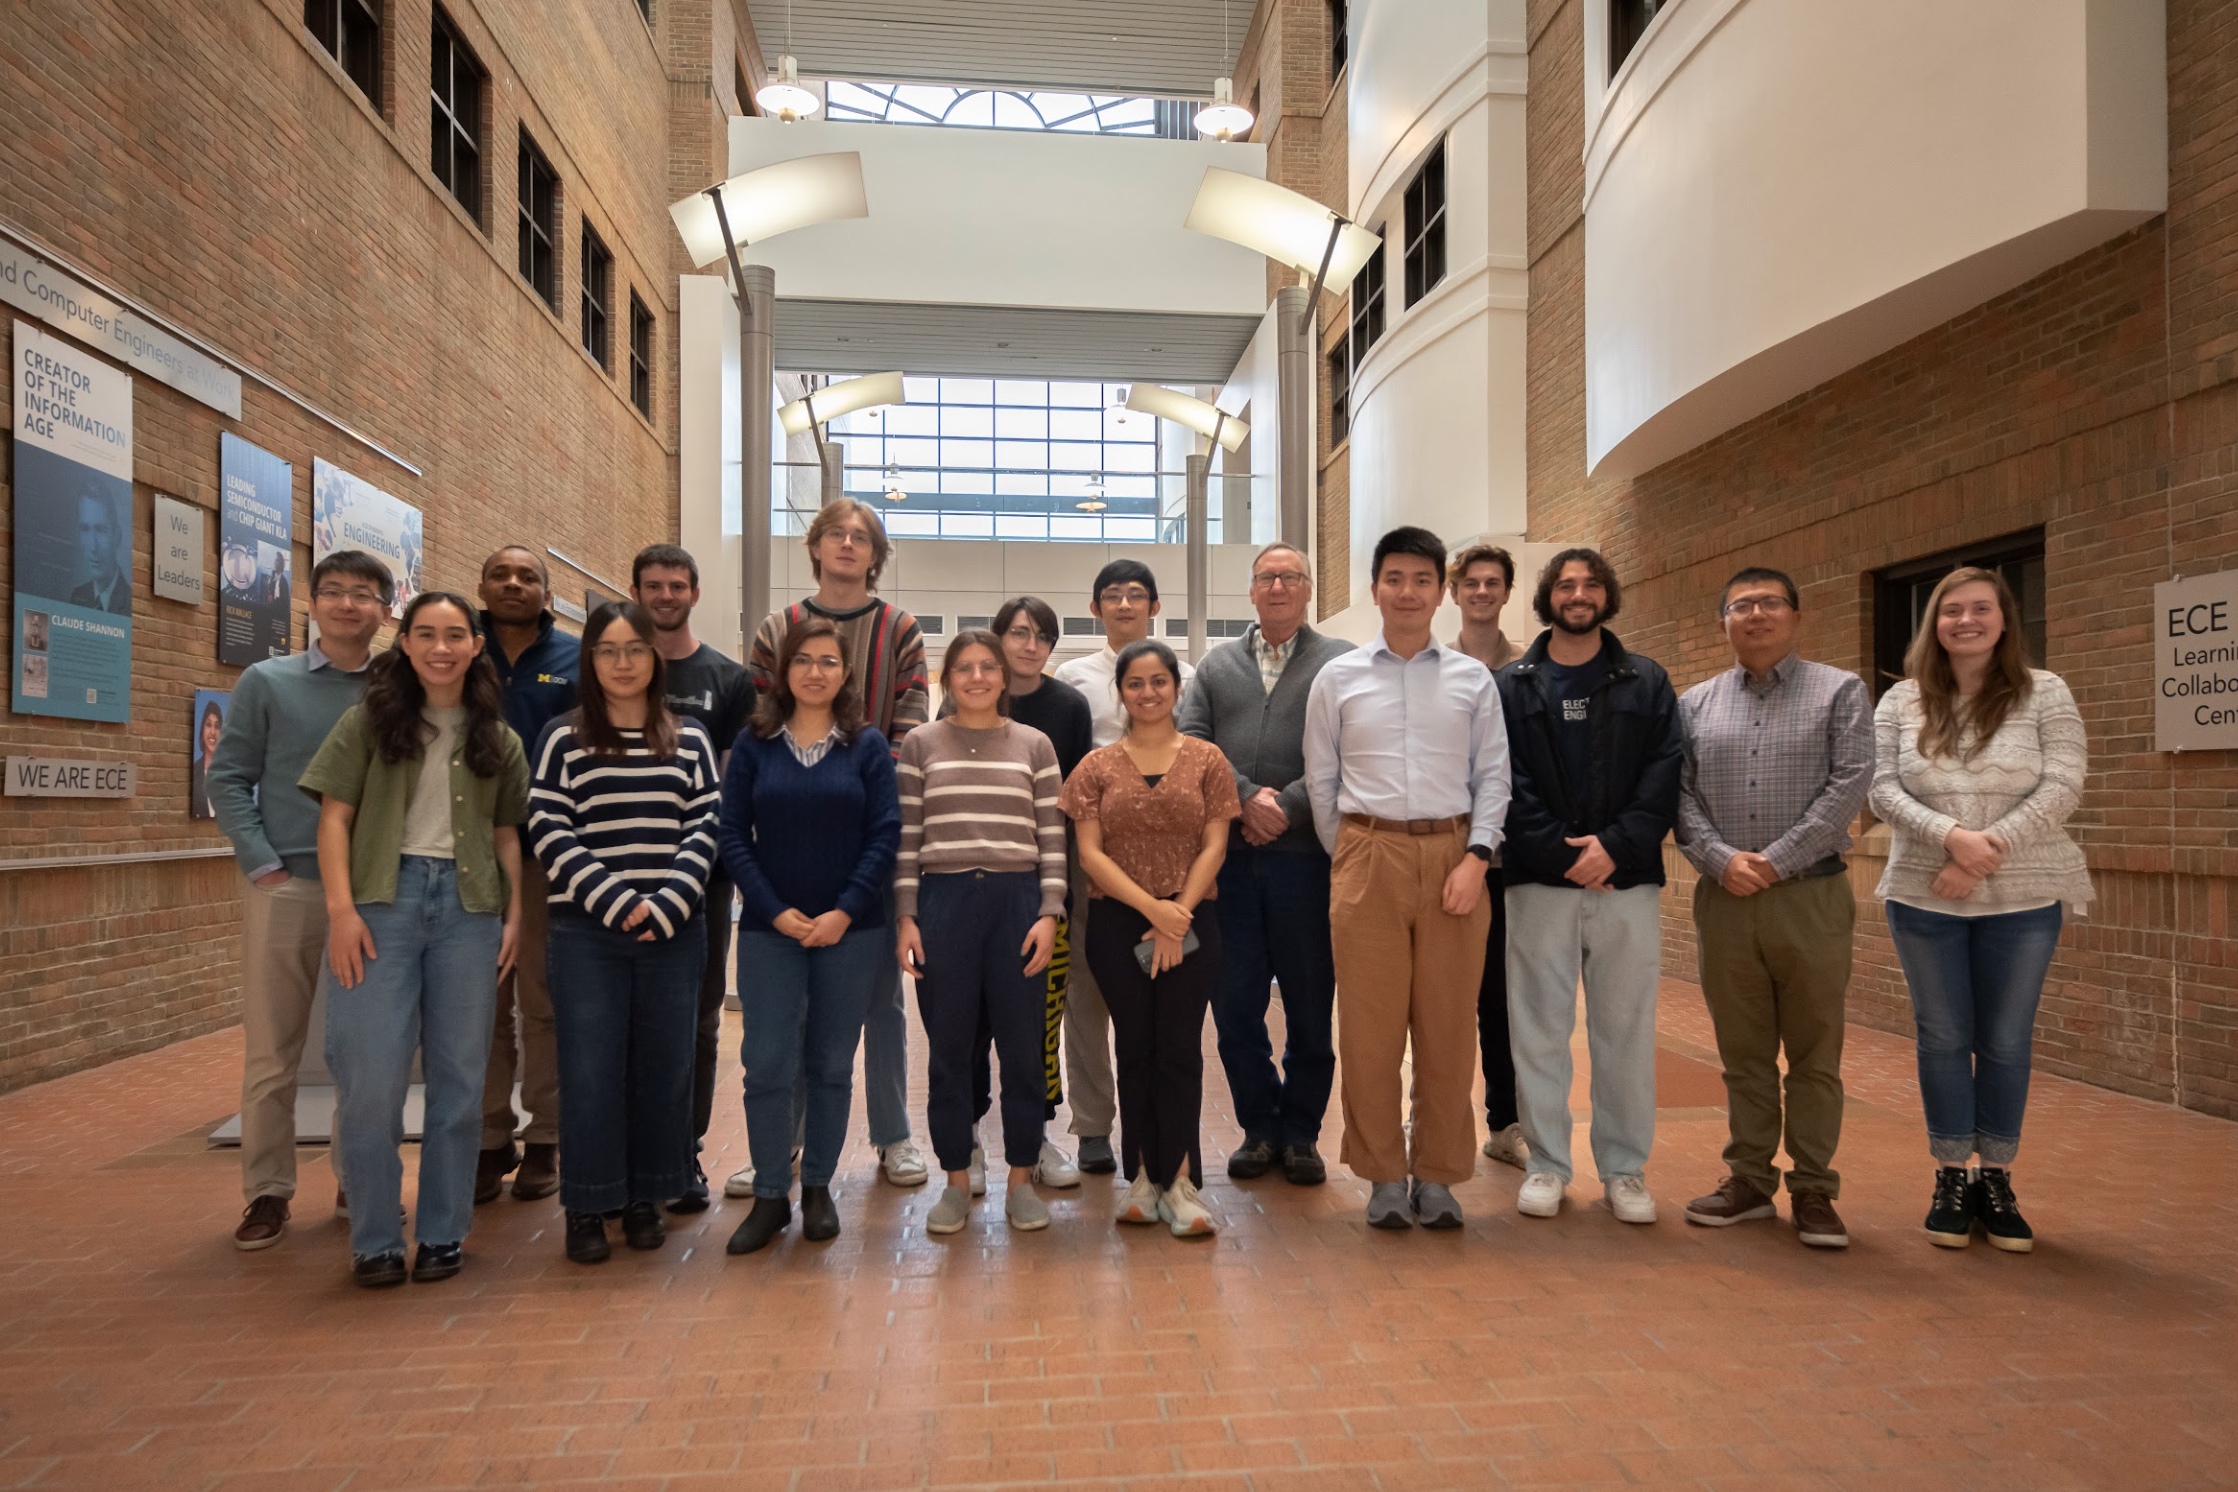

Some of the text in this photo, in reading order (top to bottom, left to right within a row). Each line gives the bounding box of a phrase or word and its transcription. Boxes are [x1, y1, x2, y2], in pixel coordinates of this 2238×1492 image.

[23, 269, 110, 333] Computer
[114, 318, 184, 375] Engineers
[187, 364, 199, 382] at
[202, 366, 235, 402] Work
[24, 348, 91, 394] CREATOR
[24, 370, 76, 407] OF THE
[24, 390, 126, 448] INFORMATION
[24, 412, 54, 439] AGE
[227, 473, 256, 497] LEADING
[227, 490, 282, 523] SEMICONDUCTOR
[170, 514, 188, 535] We
[227, 508, 238, 521] and
[239, 510, 255, 527] CHIP
[255, 517, 275, 535] GIANT
[171, 546, 188, 560] are
[344, 522, 400, 559] ENGINEERING
[158, 564, 200, 590] Leaders
[51, 614, 125, 638] CLAUDE SHANNON
[2168, 601, 2228, 637] ECE
[2173, 641, 2238, 667] Learni
[2194, 705, 2238, 726] Cen
[18, 764, 127, 790] WE ARE ECE
[1045, 919, 1071, 1100] MICHIGAN
